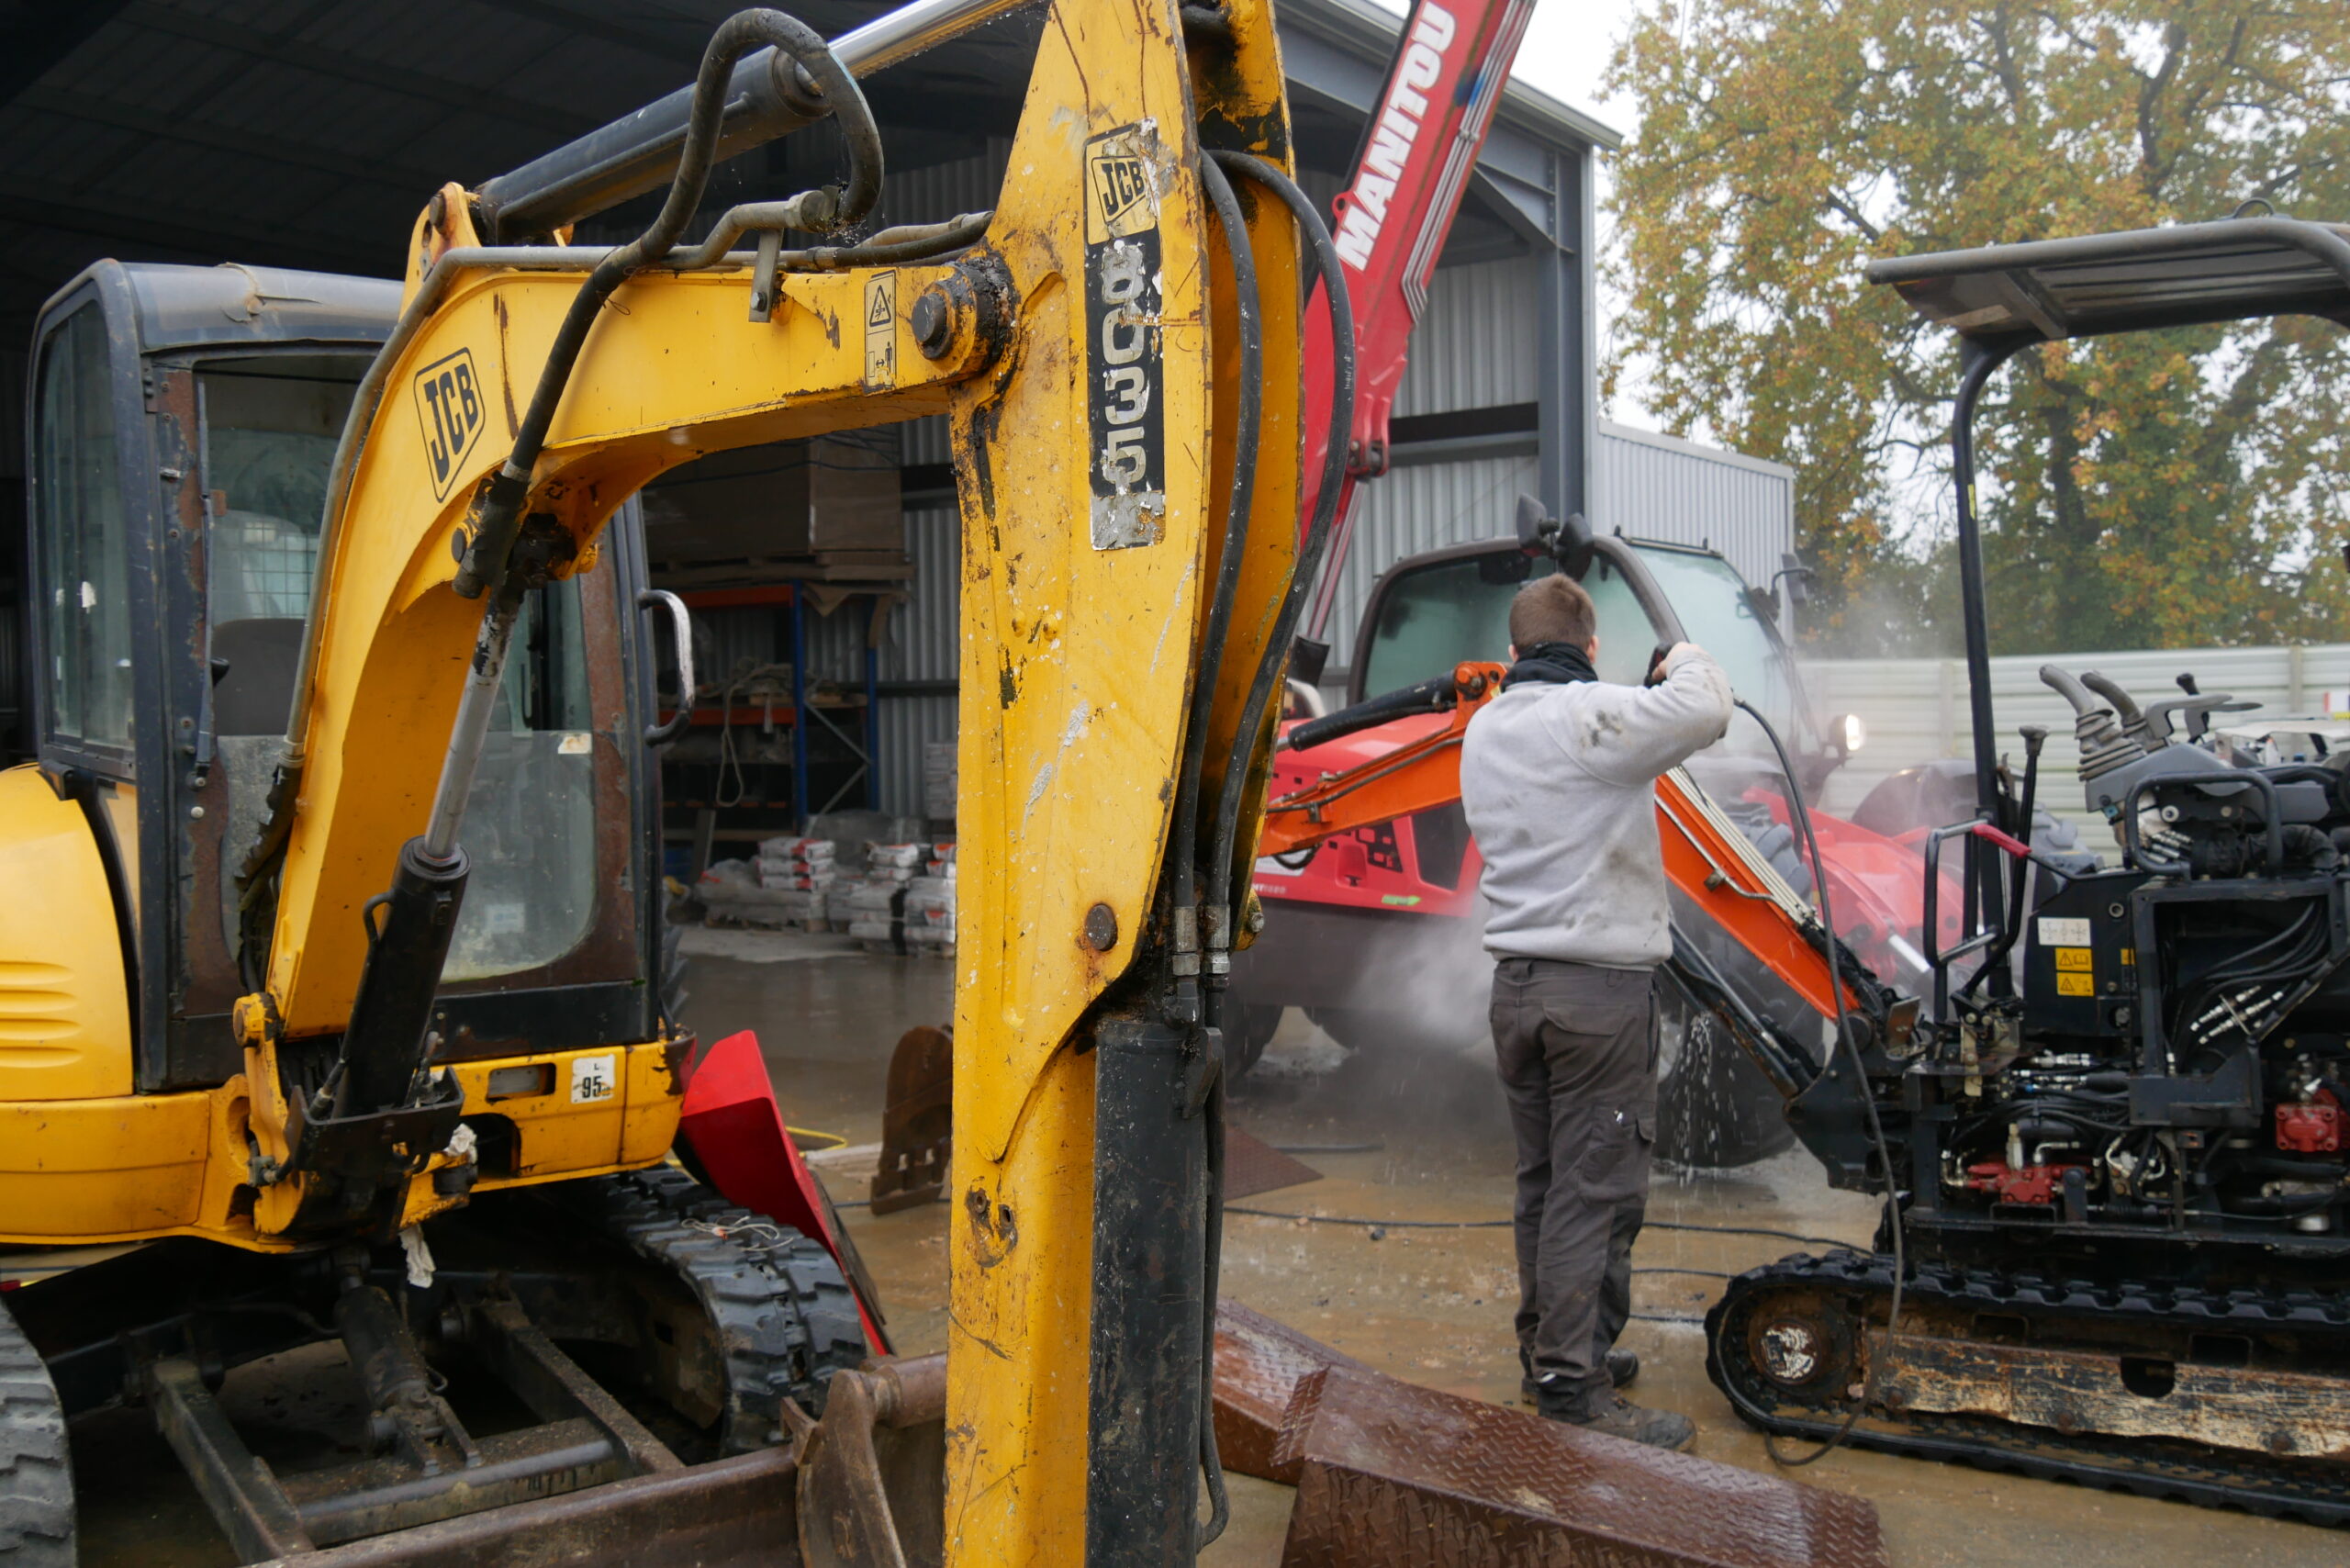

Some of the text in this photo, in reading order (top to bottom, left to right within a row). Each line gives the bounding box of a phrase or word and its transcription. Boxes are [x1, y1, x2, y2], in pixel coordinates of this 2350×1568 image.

[1334, 1, 1456, 272] MANITOU
[1101, 161, 1147, 217] JCB
[423, 363, 479, 484] JCB
[581, 1075, 602, 1099] 95
